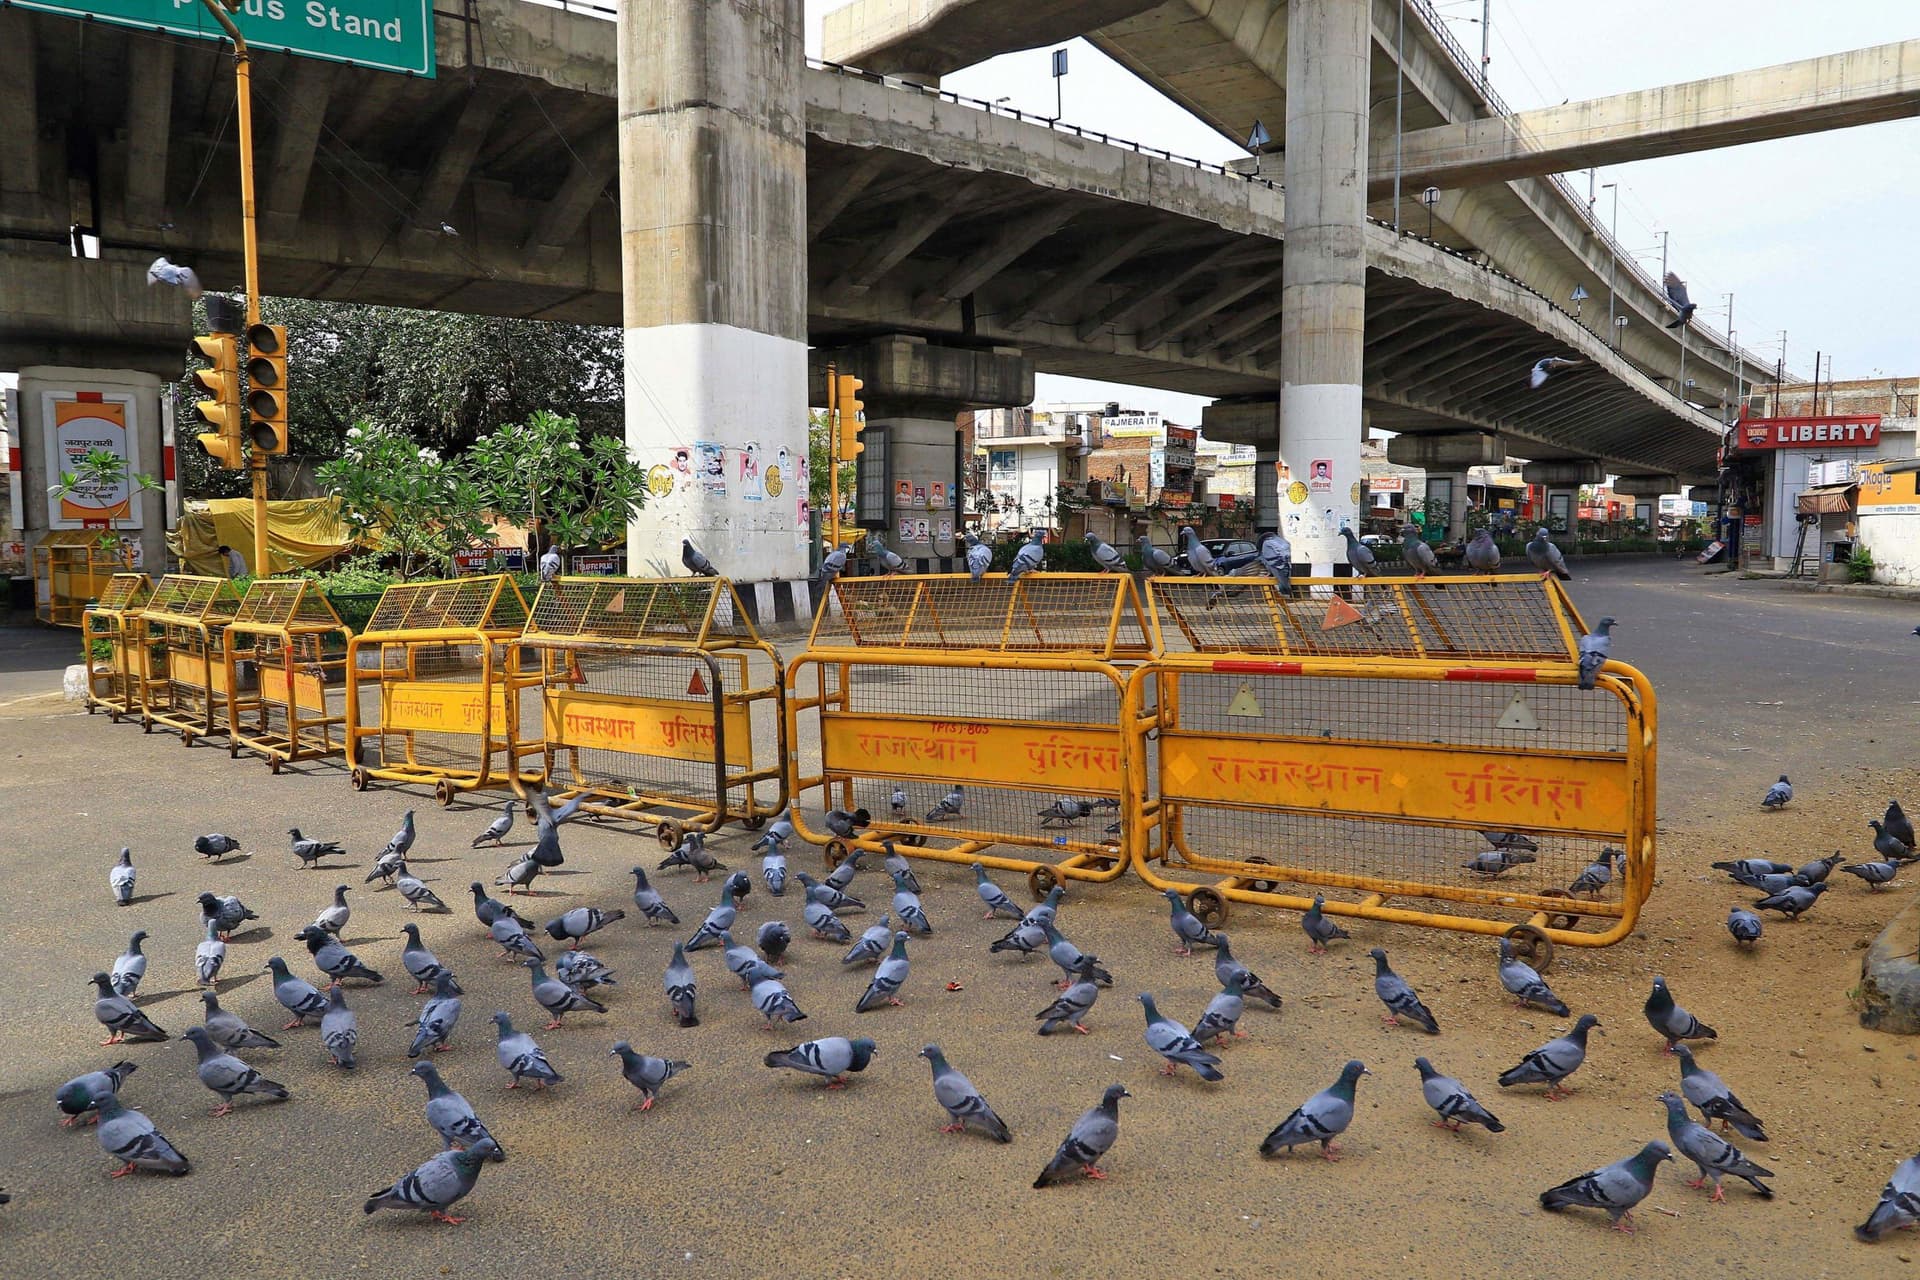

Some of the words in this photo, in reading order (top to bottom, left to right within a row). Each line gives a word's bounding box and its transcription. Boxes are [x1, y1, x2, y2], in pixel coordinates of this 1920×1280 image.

[219, 0, 285, 20] us
[306, 1, 402, 42] Stand
[1111, 417, 1144, 426] AJMERA
[1147, 416, 1158, 425] ITI
[1777, 423, 1877, 442] LIBERTY
[565, 713, 636, 740] राजस्थान
[660, 714, 716, 747] पुलिस
[857, 734, 978, 765] राजस्थान
[1023, 734, 1120, 775] पुलिस
[1208, 756, 1384, 794] राजस्थान
[1445, 763, 1588, 811] पुलिस
